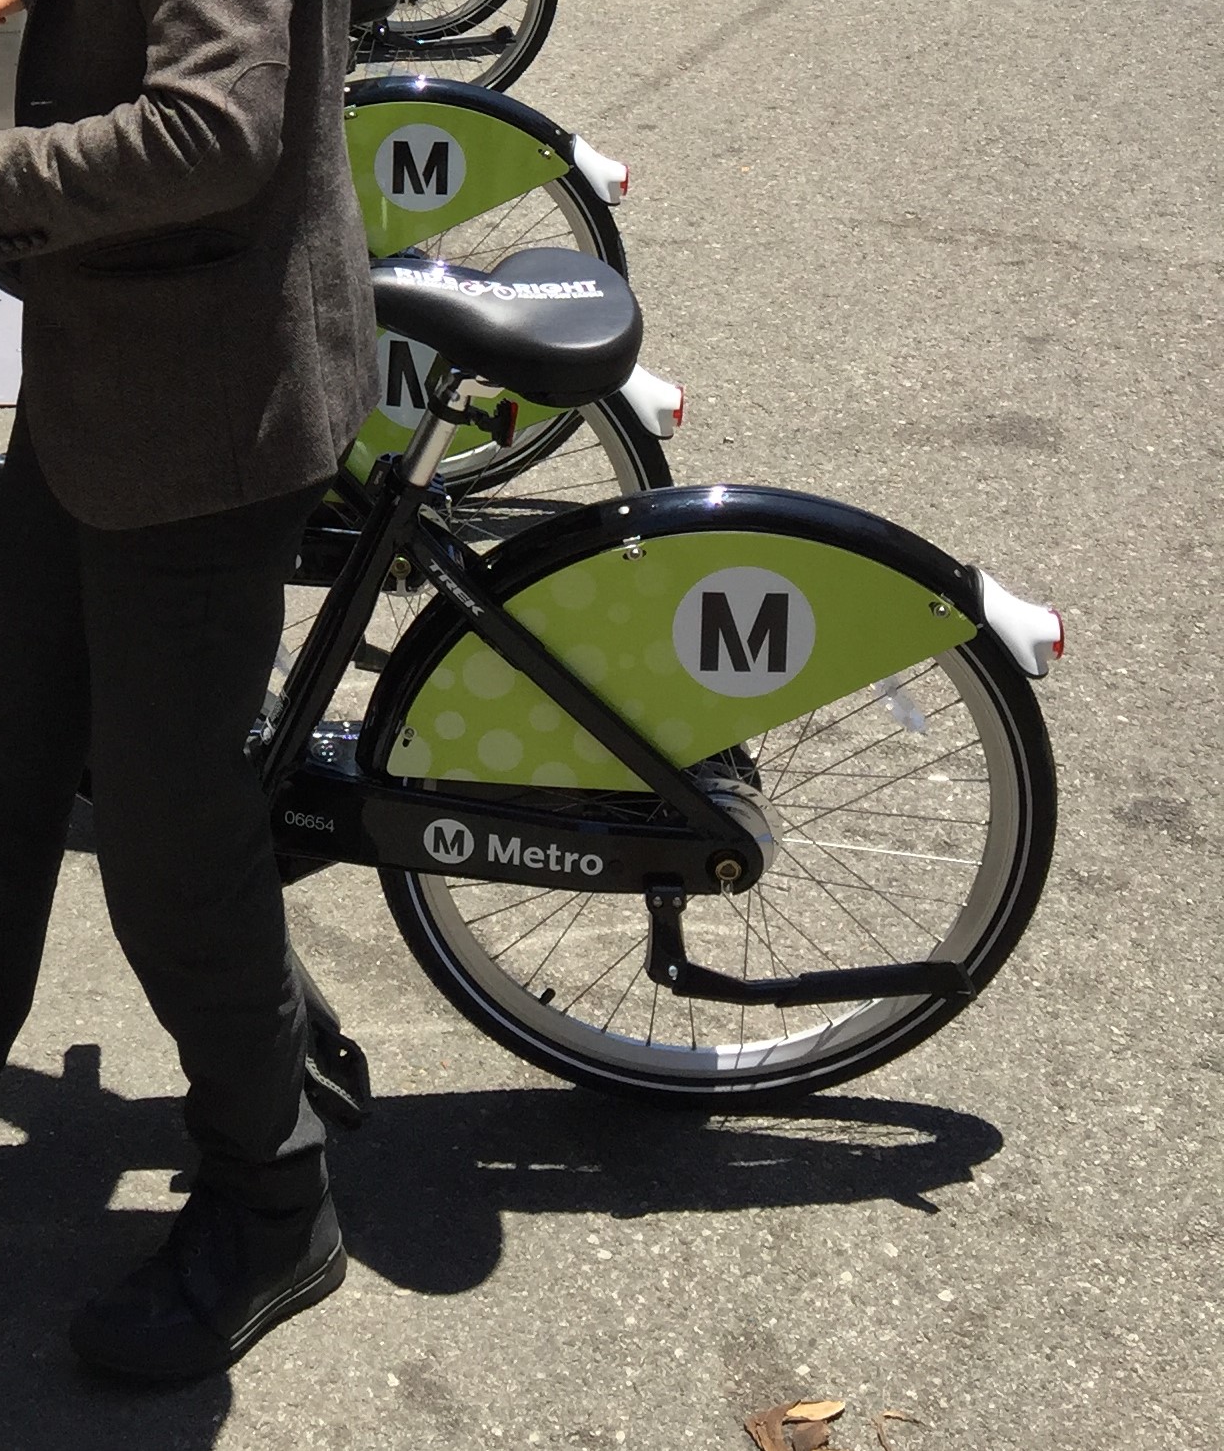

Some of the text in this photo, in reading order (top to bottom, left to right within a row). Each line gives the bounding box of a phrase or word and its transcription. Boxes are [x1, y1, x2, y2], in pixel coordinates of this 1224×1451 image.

[392, 140, 449, 195] M
[513, 280, 597, 294] RIGHT
[429, 558, 485, 617] TREK
[700, 592, 789, 674] M
[284, 810, 335, 834] 06654
[432, 826, 604, 877] M Metro
